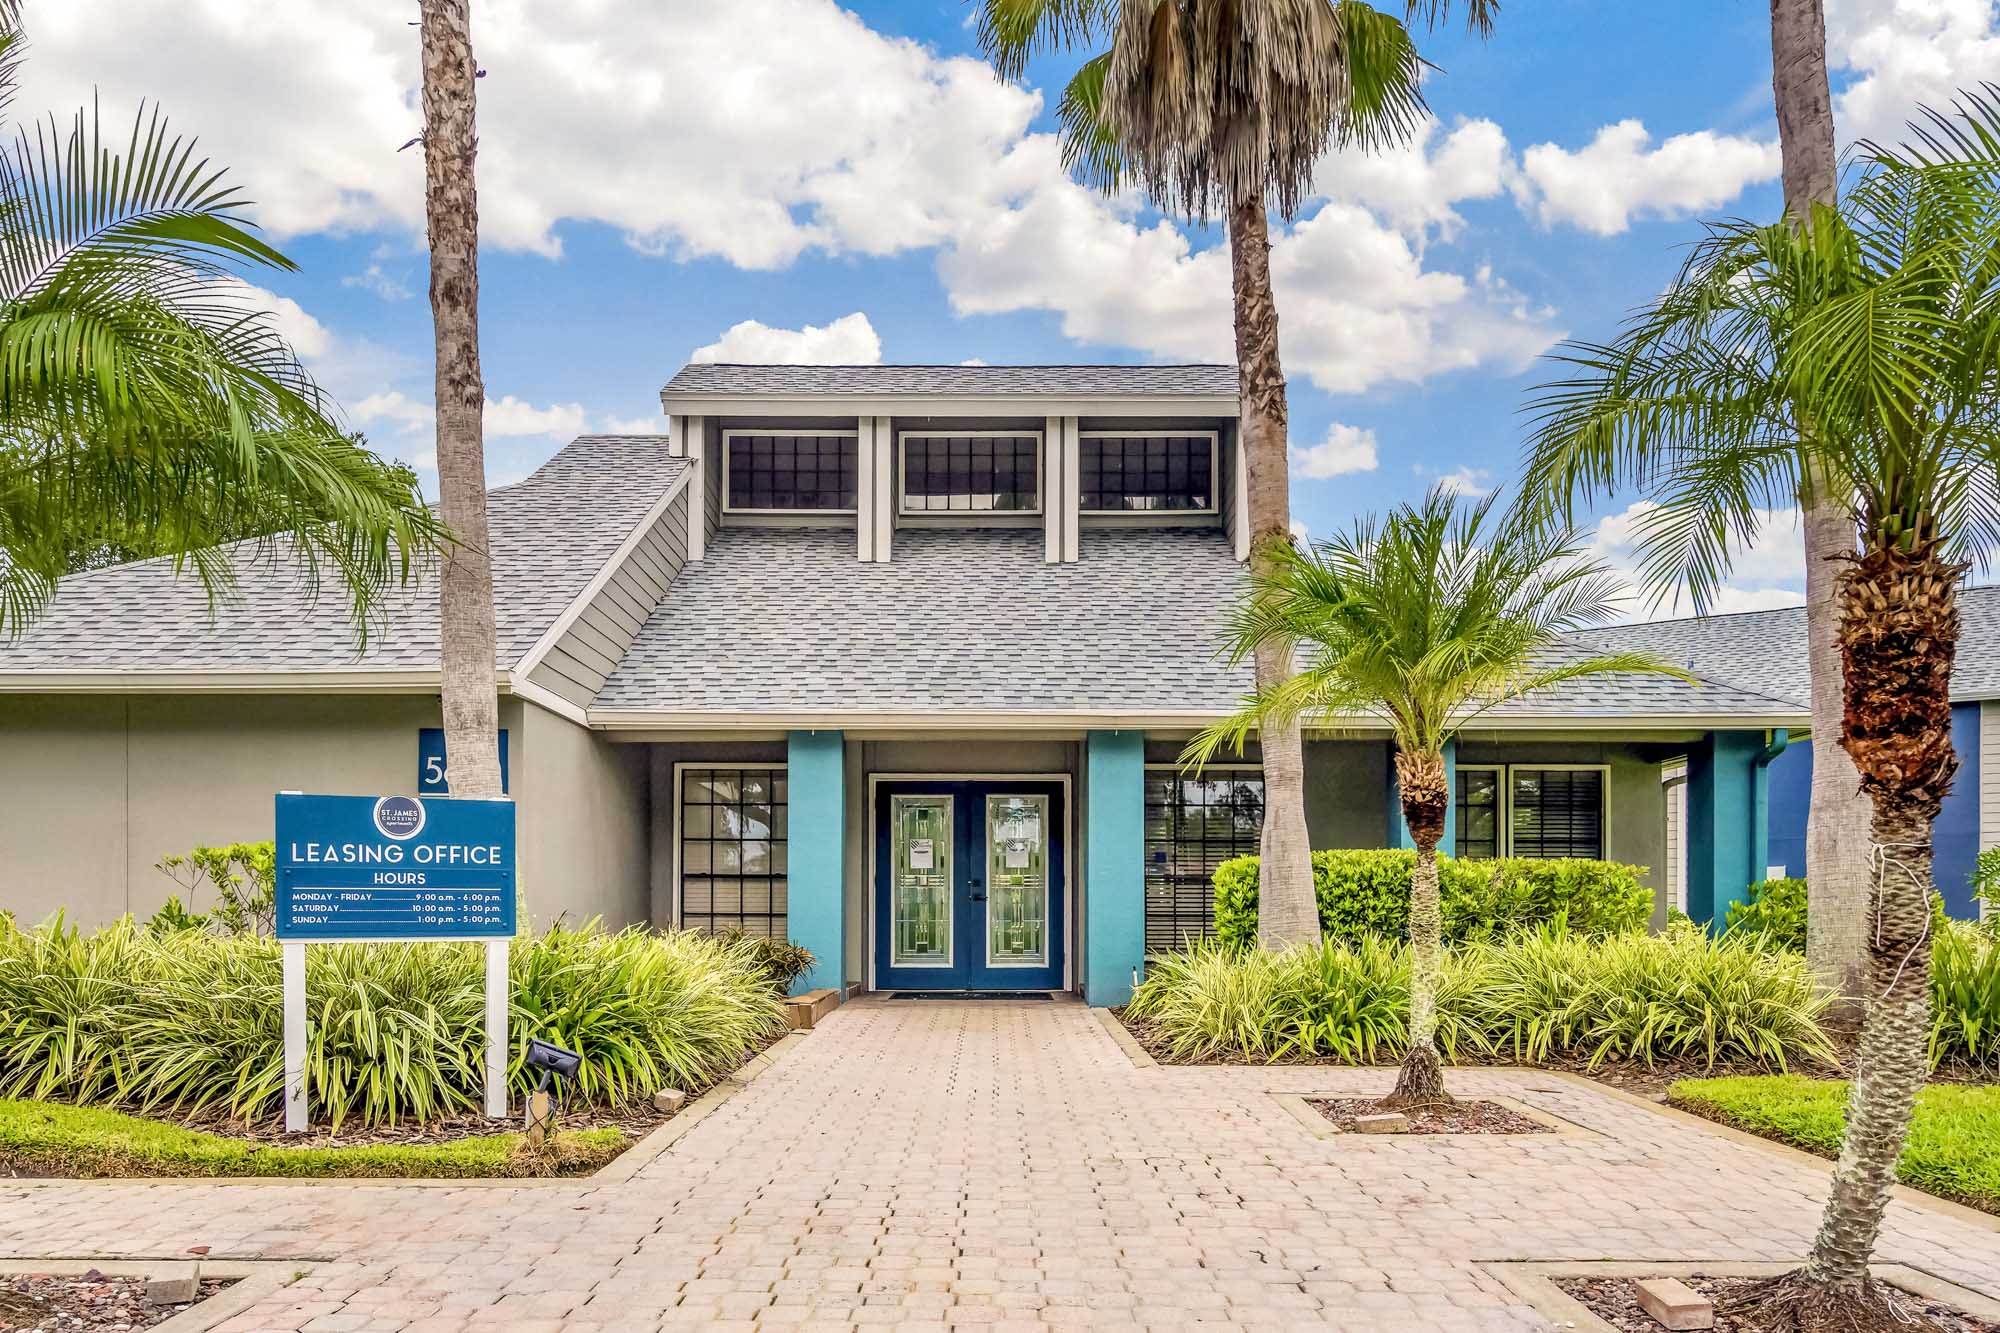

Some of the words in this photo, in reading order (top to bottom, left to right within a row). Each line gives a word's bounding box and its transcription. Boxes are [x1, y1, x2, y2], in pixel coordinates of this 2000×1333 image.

[394, 809, 418, 817] JAMES
[292, 843, 403, 863] LEASING
[414, 845, 501, 864] OFFICE
[374, 872, 426, 885] HOURS
[292, 893, 333, 901] MONDAY
[340, 893, 372, 901] FRIDAY
[416, 893, 436, 901] 9:00
[463, 893, 483, 901] 6:00
[484, 894, 501, 903] p.m.
[292, 904, 339, 912] SATURDAY
[412, 904, 436, 912] 10:00
[463, 904, 483, 912] 5:00
[484, 906, 502, 915] p.m.
[292, 916, 328, 924] SUNDAY
[438, 917, 456, 926] p.m.
[484, 917, 502, 926] p.m.
